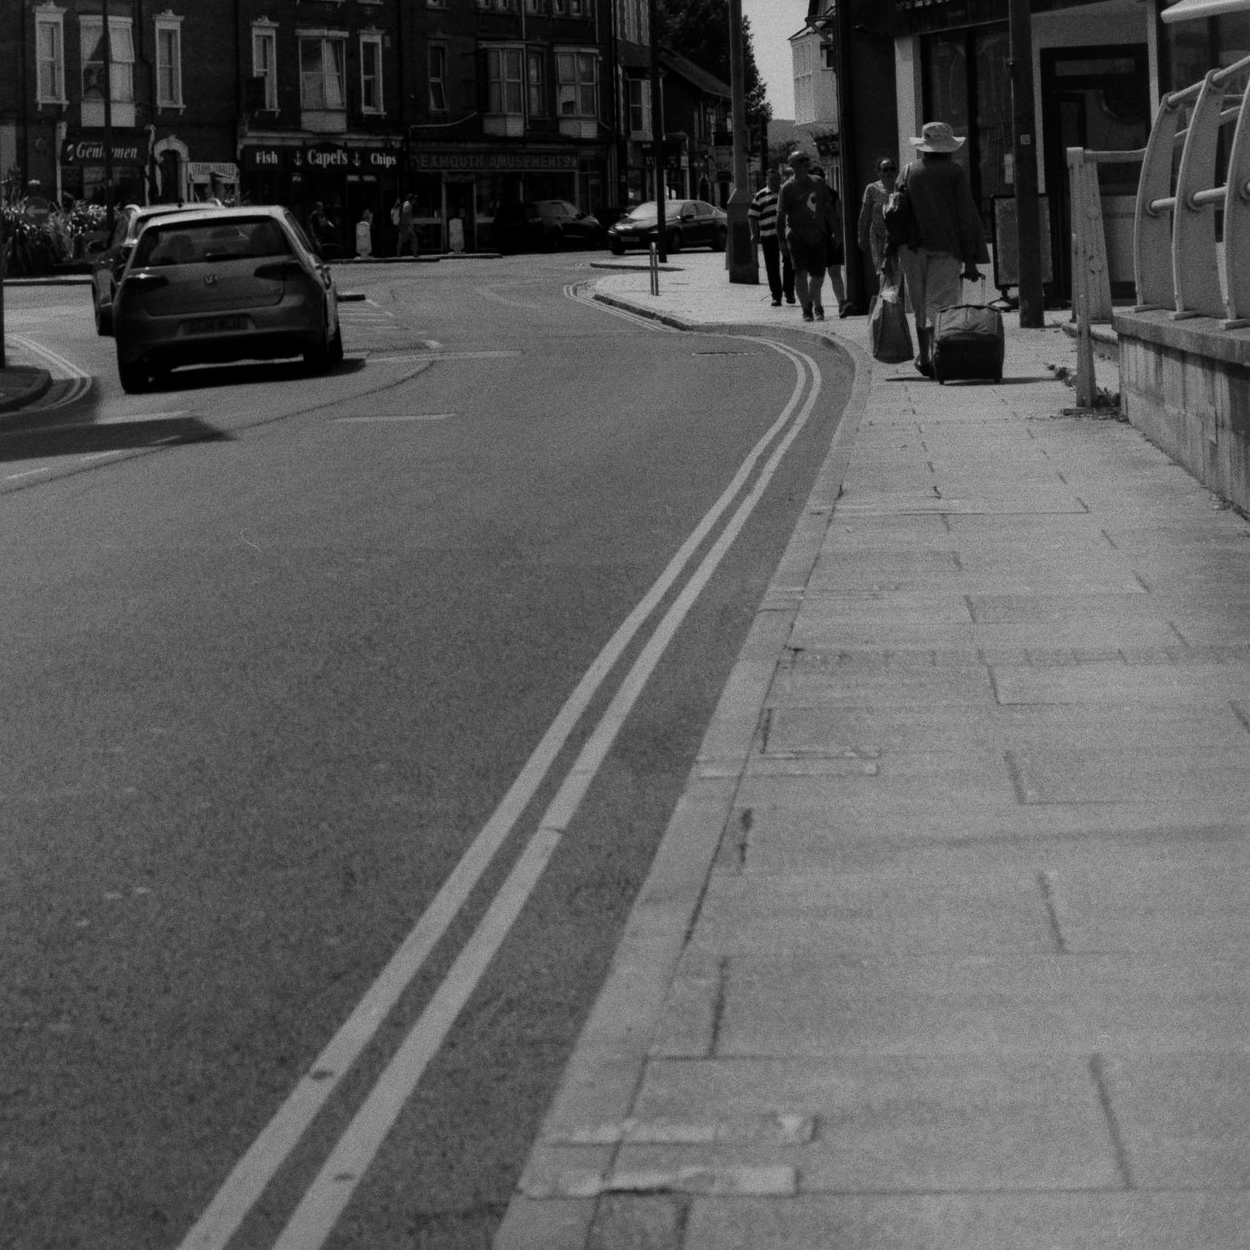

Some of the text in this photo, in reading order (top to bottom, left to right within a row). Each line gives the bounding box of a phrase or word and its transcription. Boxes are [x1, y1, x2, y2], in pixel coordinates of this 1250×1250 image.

[76, 141, 137, 159] Gentmen
[255, 149, 397, 168] Fish Capel's Chips
[420, 153, 485, 168] EXMOUTH
